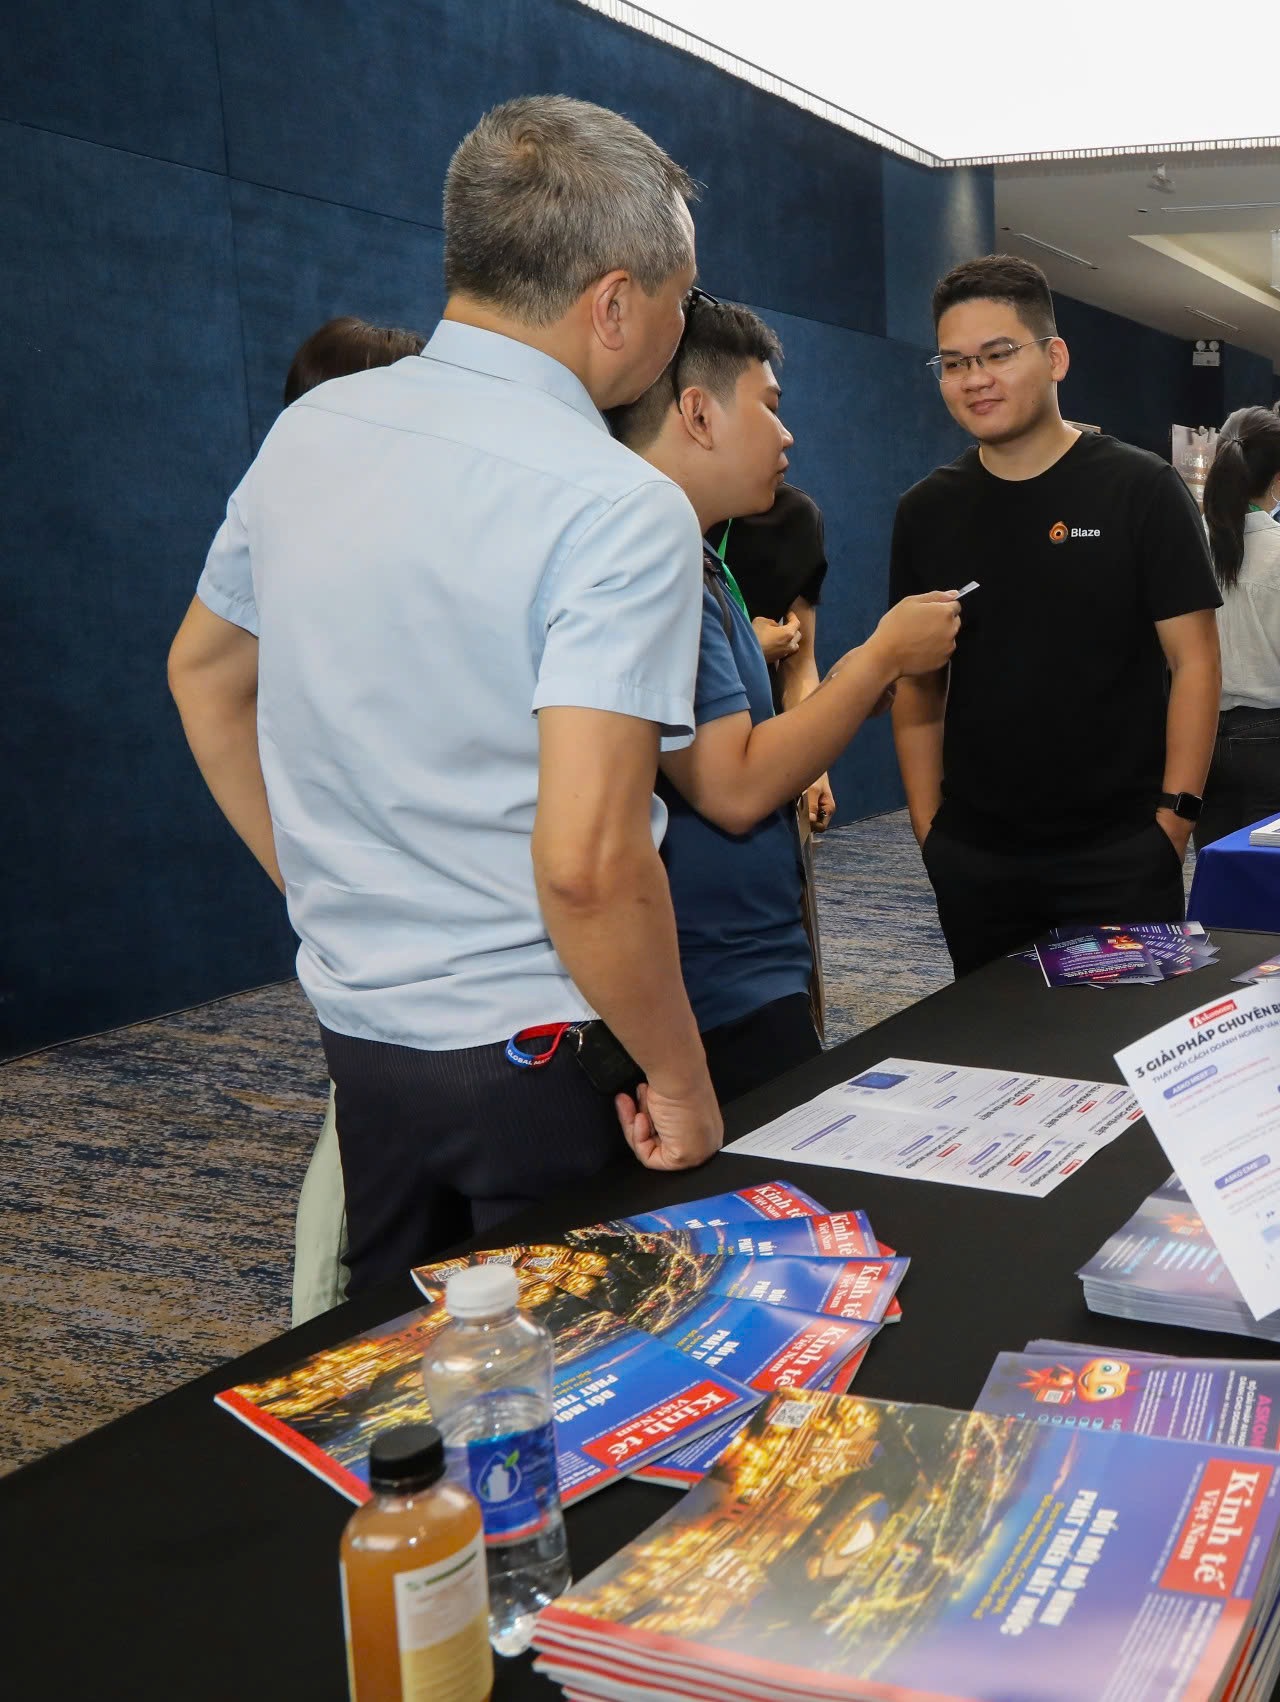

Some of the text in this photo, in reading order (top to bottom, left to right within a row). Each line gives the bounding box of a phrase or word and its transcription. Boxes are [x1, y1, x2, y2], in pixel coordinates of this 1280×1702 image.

[1071, 527, 1101, 538] Blaze
[1135, 1067, 1145, 1079] 3
[1146, 1048, 1176, 1073] GIẢI
[1176, 1028, 1215, 1056] PHÁP
[1217, 1005, 1272, 1034] CHUYÊN
[1152, 1069, 1173, 1084] THAY
[1188, 1047, 1210, 1065] CÁCH
[1210, 1035, 1238, 1054] DOANH
[752, 1194, 781, 1219] Việt Nam
[755, 1186, 788, 1210] Kinh
[818, 1222, 831, 1250] Việt Nam
[830, 1214, 853, 1247] Kinh
[830, 1272, 857, 1309] Việt Nam
[850, 1264, 882, 1300] Kinh
[699, 1329, 731, 1353] PHÁT
[716, 1340, 740, 1358] ĐỔI
[769, 1333, 818, 1373] Việt Nam
[794, 1325, 850, 1367] Kinh
[579, 1374, 619, 1398] PHÁT
[553, 1389, 616, 1424] ĐỔI MỚI
[615, 1398, 690, 1439] Việt Nam
[607, 1391, 726, 1462] Kinh tế
[1089, 1509, 1119, 1536] ĐỔI
[1178, 1488, 1221, 1561] Việt Nam
[1208, 1470, 1260, 1546] Kinh
[1000, 1489, 1098, 1637] PHÁT TRIỂN ĐẤT NƯỚC
[1194, 1552, 1228, 1591] tế
